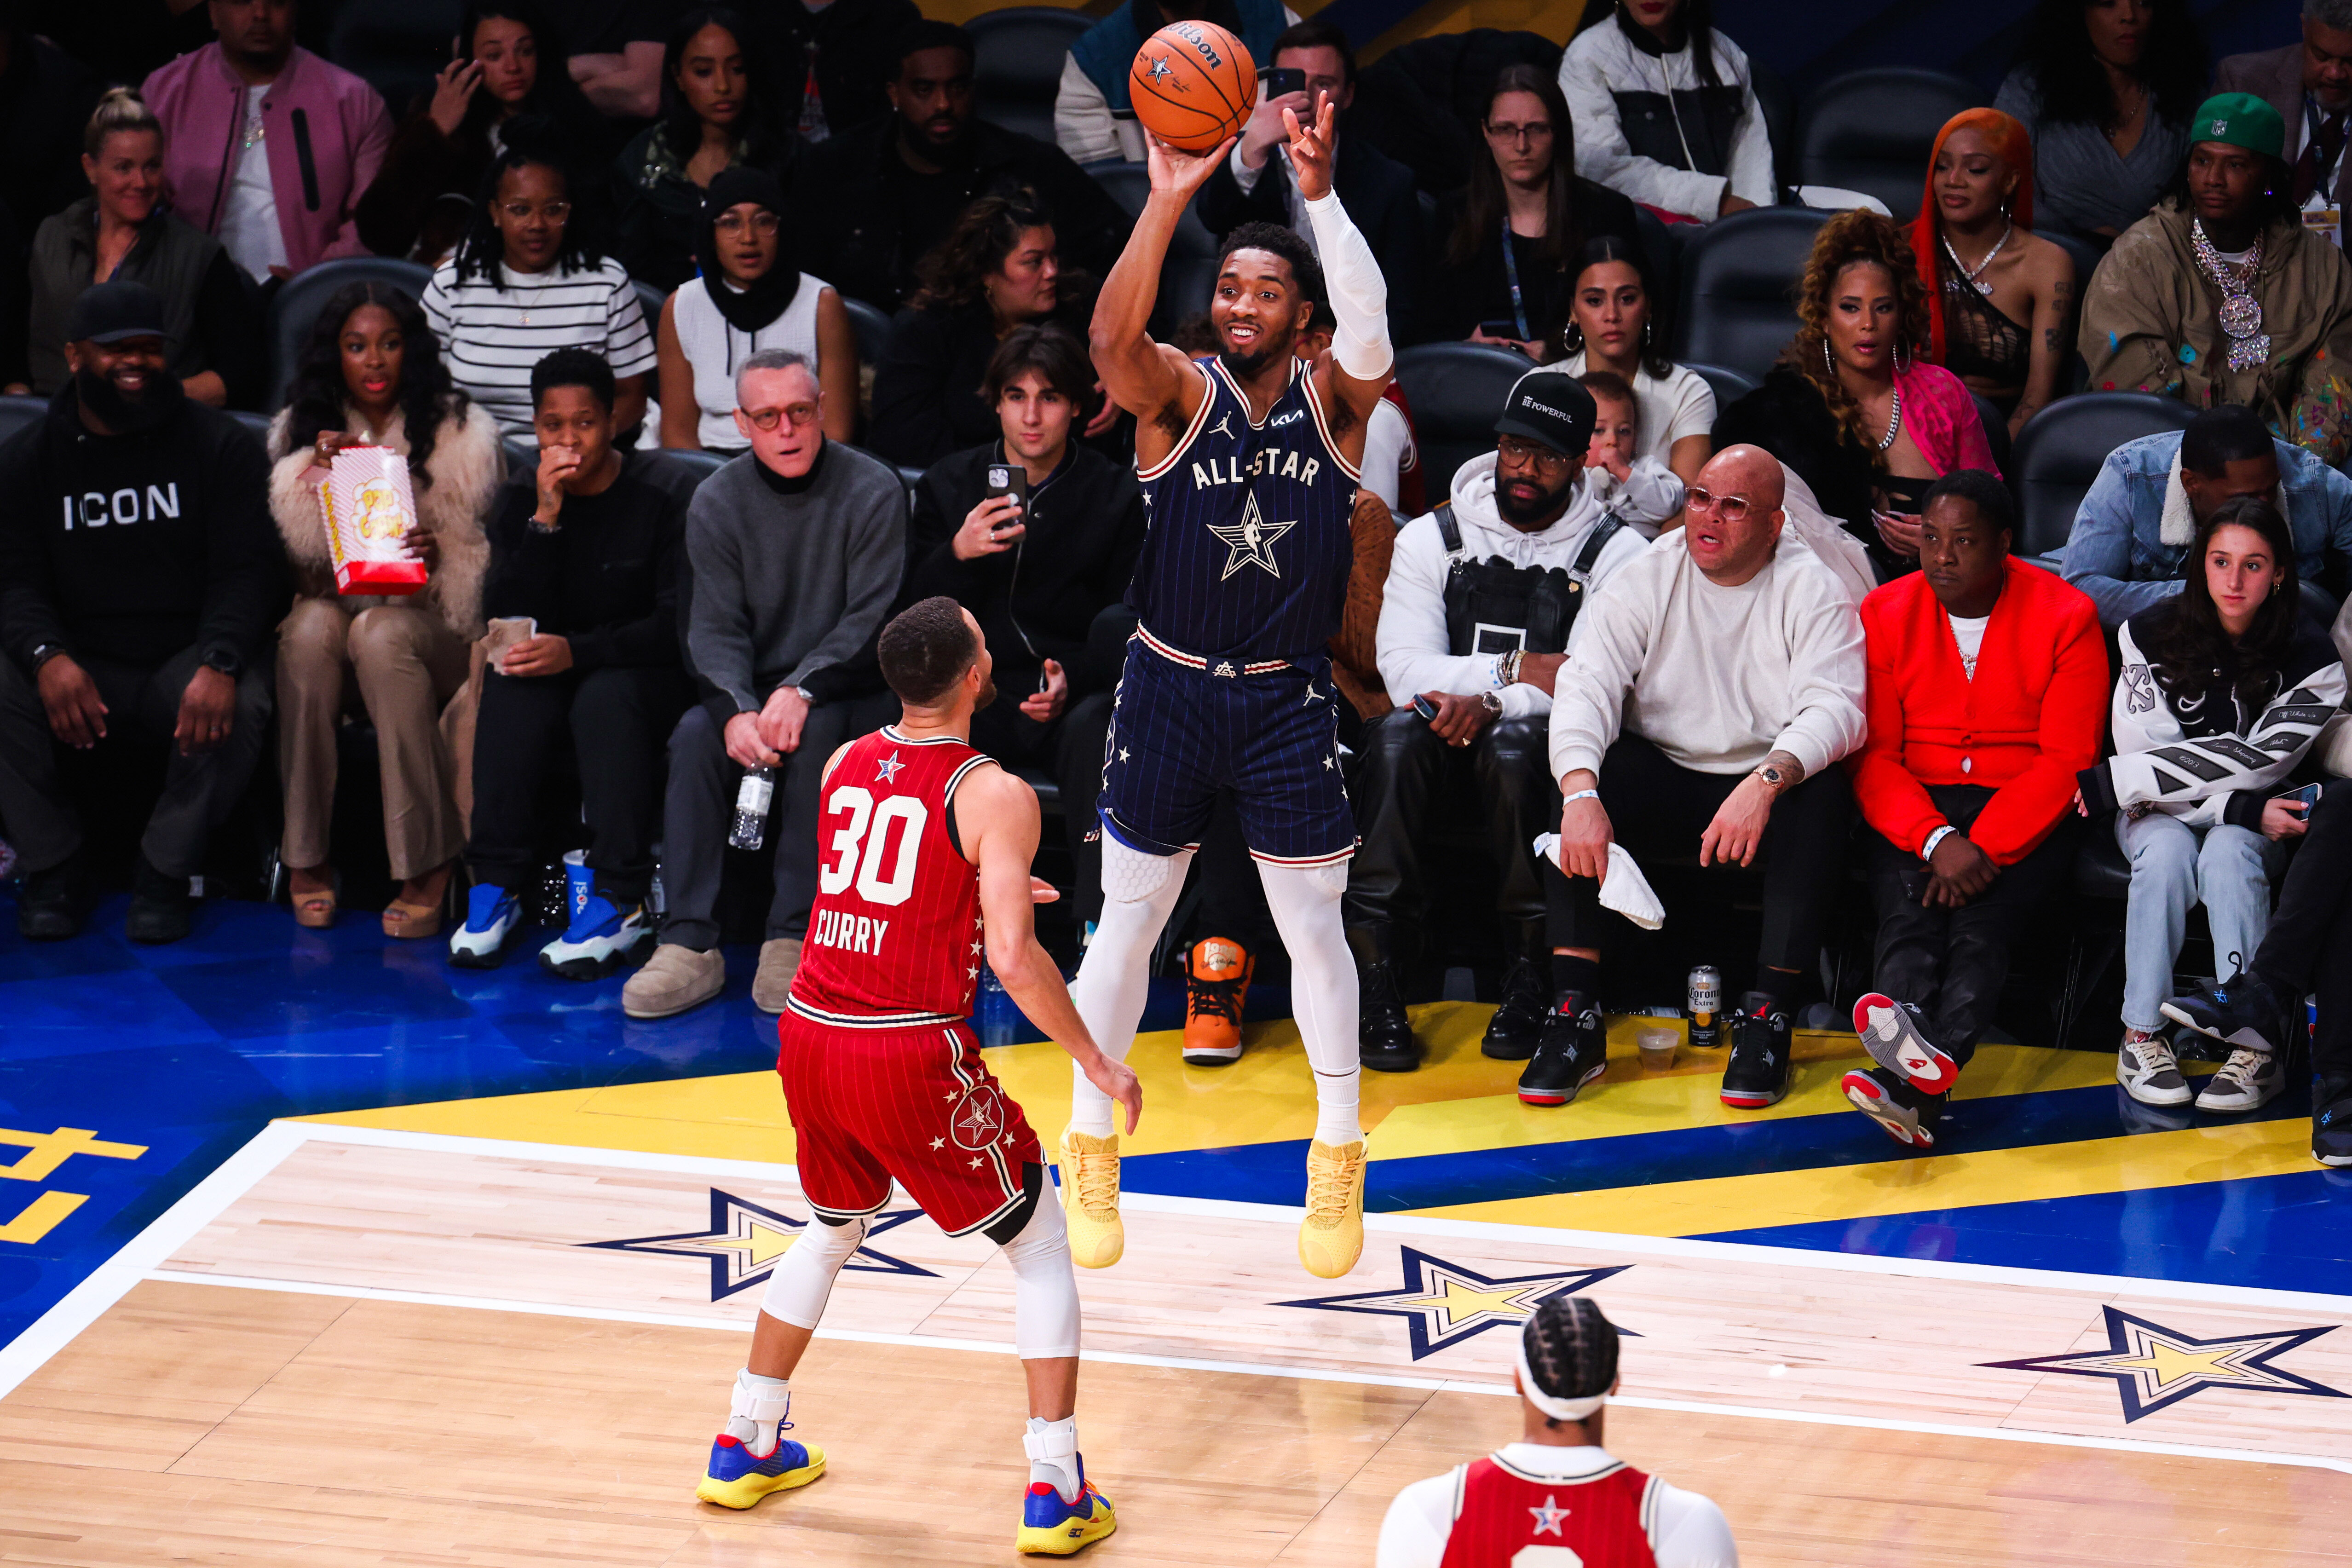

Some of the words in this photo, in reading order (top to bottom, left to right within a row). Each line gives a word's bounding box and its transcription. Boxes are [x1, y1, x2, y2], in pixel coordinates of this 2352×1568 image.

[1163, 22, 1222, 70] Wilson
[1522, 398, 1532, 408] BE
[1531, 402, 1573, 423] POWERFUL
[1192, 448, 1320, 490] ALL-STAR
[63, 482, 180, 531] ICON
[820, 785, 928, 906] 30
[814, 909, 889, 956] CURRY
